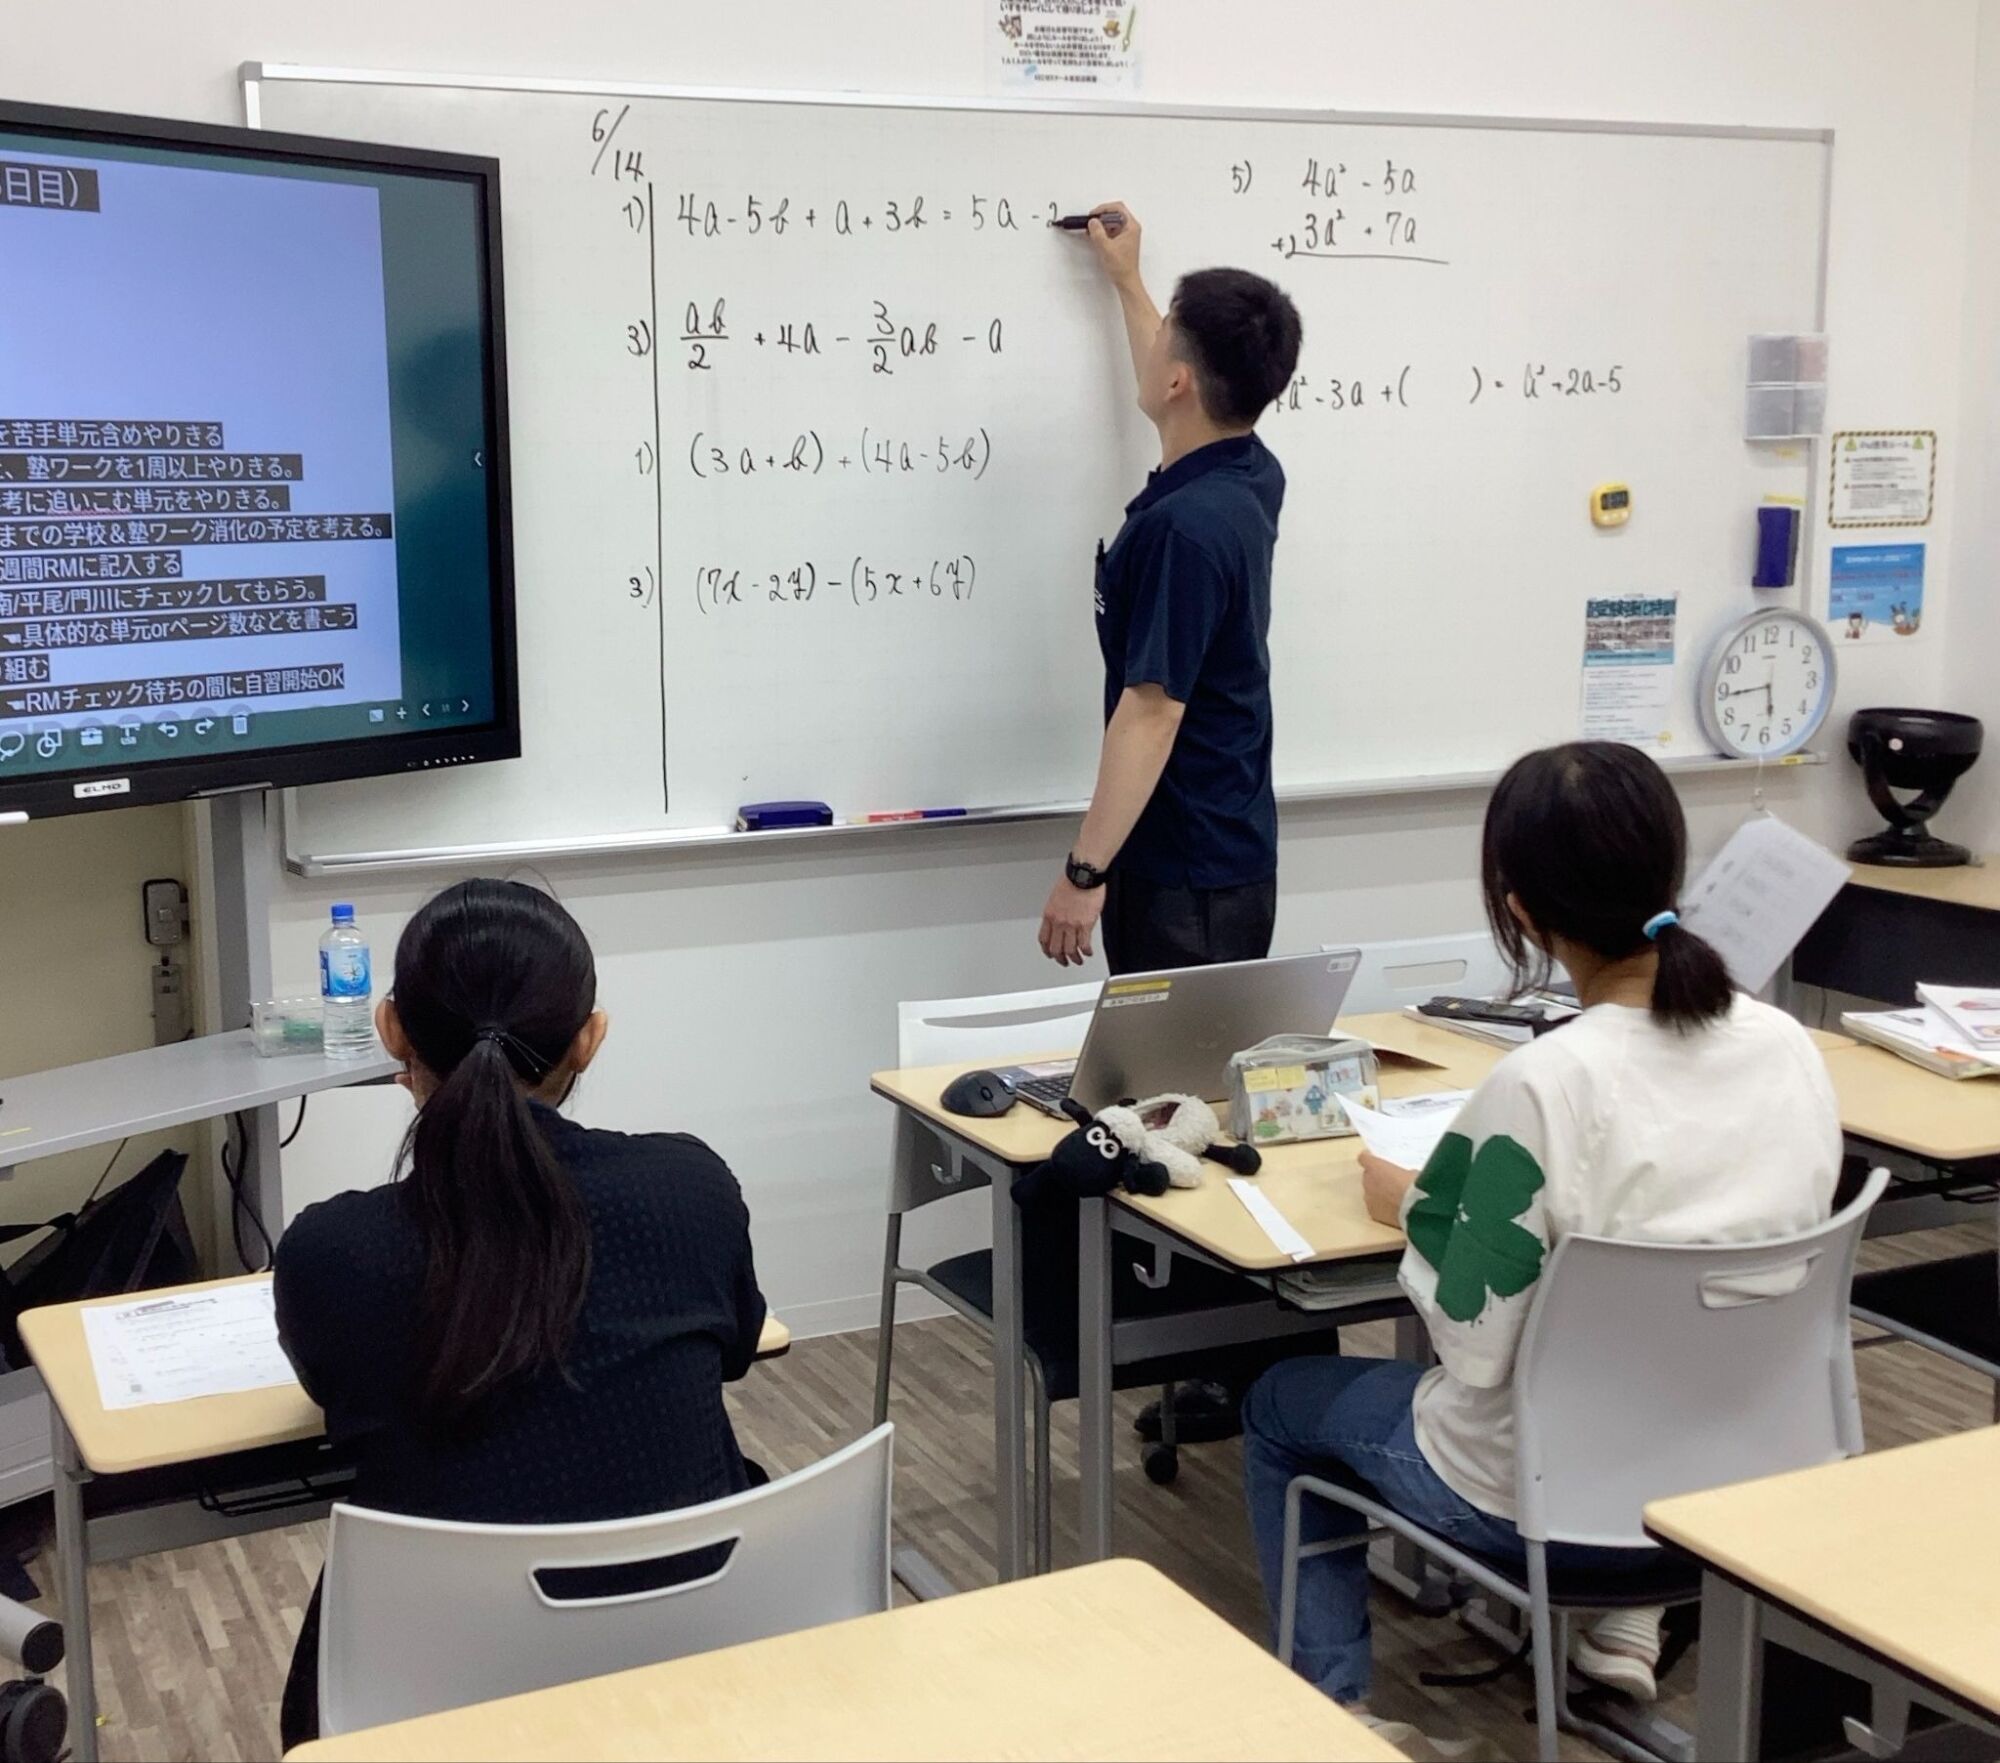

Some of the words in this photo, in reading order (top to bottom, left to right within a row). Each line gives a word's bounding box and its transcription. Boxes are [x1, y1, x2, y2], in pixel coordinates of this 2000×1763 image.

[0, 166, 79, 208] 日目)
[1231, 159, 1253, 194] 5)
[621, 194, 645, 234] 1)
[626, 318, 652, 357] 3)
[0, 454, 292, 480] 、塾ワークを1周以上やりきる。
[634, 440, 654, 476] 1)
[0, 488, 279, 515] 考に追いこむ単元をやりきる。
[0, 553, 181, 582] 週間RMに記入する
[628, 565, 655, 609] 3)
[1743, 634, 1757, 654] 11
[1763, 624, 1780, 646] 12
[1788, 629, 1795, 649] 1
[1724, 654, 1742, 675] 10
[1801, 645, 1813, 665] 2
[0, 656, 48, 682] 組む
[1805, 670, 1818, 690] 3
[1717, 681, 1731, 702] 9
[1723, 706, 1736, 726] 8
[1780, 717, 1793, 736] 5
[1740, 723, 1751, 742] 7
[1758, 725, 1772, 746] 6
[82, 782, 122, 793] ELMO
